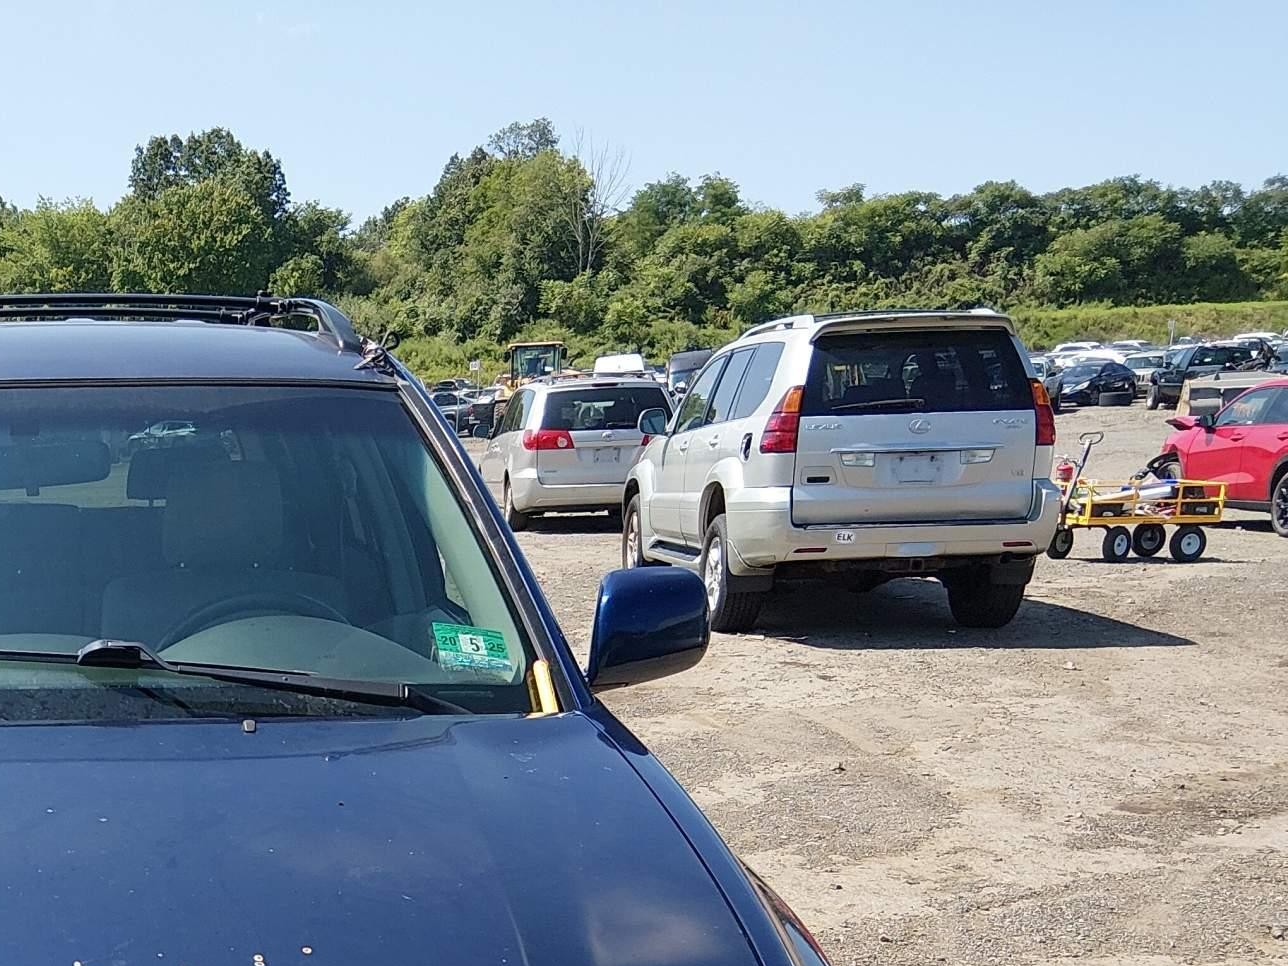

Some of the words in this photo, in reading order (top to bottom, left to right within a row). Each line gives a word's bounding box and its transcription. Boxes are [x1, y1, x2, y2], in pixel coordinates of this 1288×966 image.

[837, 533, 854, 541] ELK
[441, 636, 457, 646] 20
[469, 638, 481, 652] 5
[488, 642, 505, 653] 25
